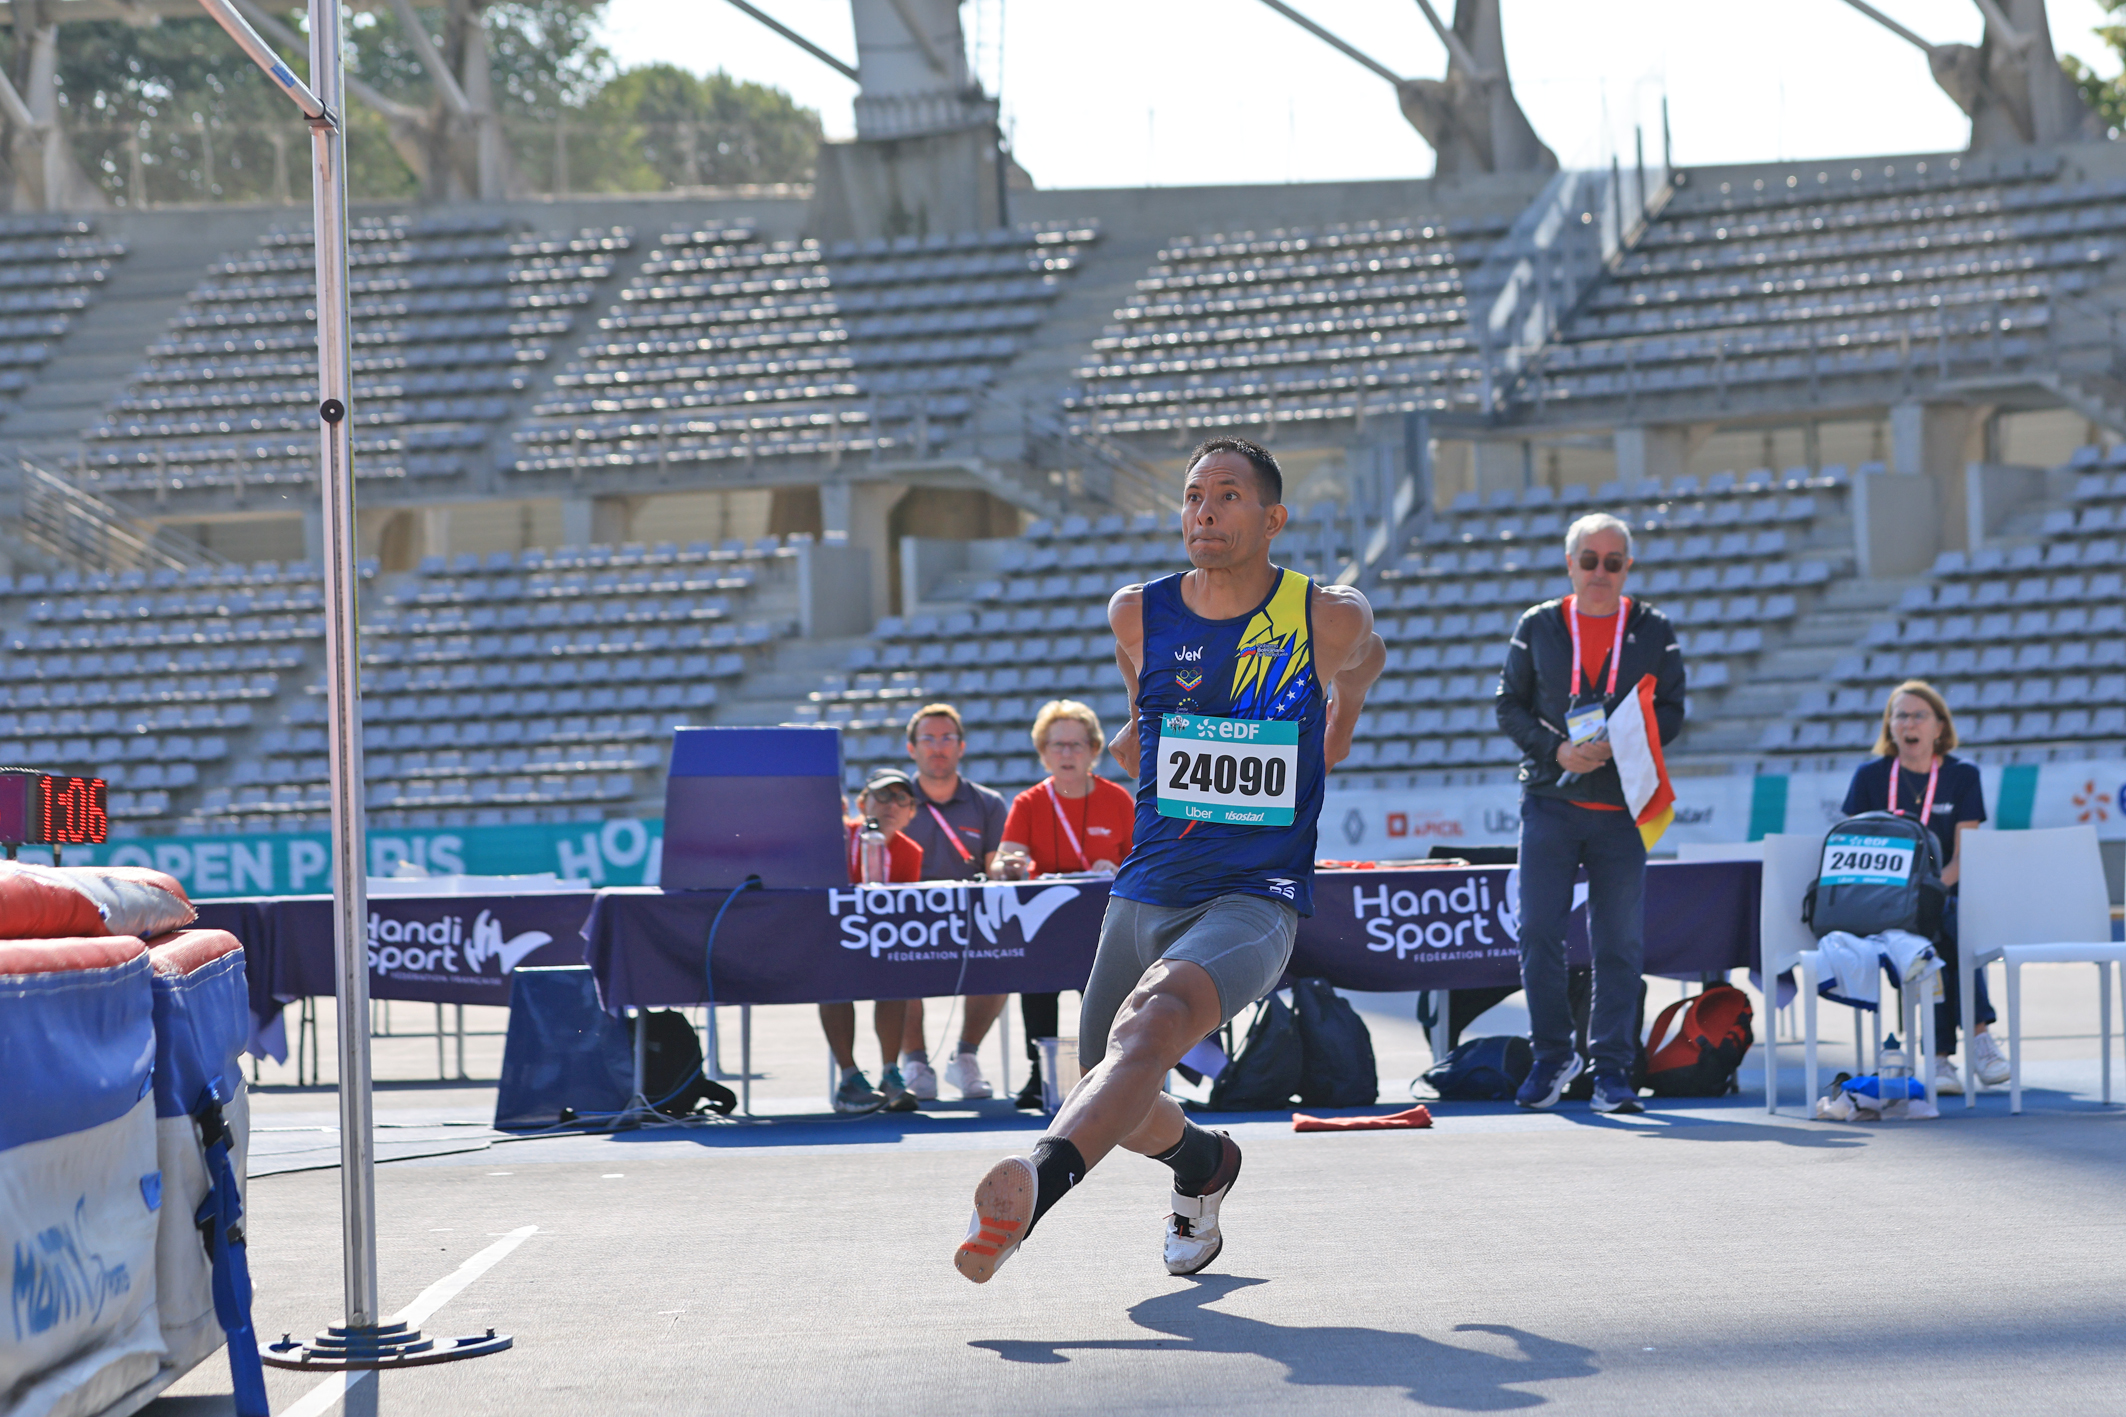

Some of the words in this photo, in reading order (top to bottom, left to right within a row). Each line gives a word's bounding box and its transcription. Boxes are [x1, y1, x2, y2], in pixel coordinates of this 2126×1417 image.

[1169, 750, 1286, 797] 24090
[40, 776, 107, 843] 1:06
[1185, 805, 1213, 819] Uber
[1484, 808, 1519, 834] Ub
[109, 840, 273, 893] OPEN
[288, 835, 466, 889] PRIS
[1830, 851, 1904, 872] 24090
[1353, 876, 1491, 919] Handi
[839, 912, 969, 958] Sport
[887, 950, 959, 962] FÉDÉRATION
[1366, 912, 1494, 960] Sport
[1413, 949, 1484, 962] FÉDÉRATION
